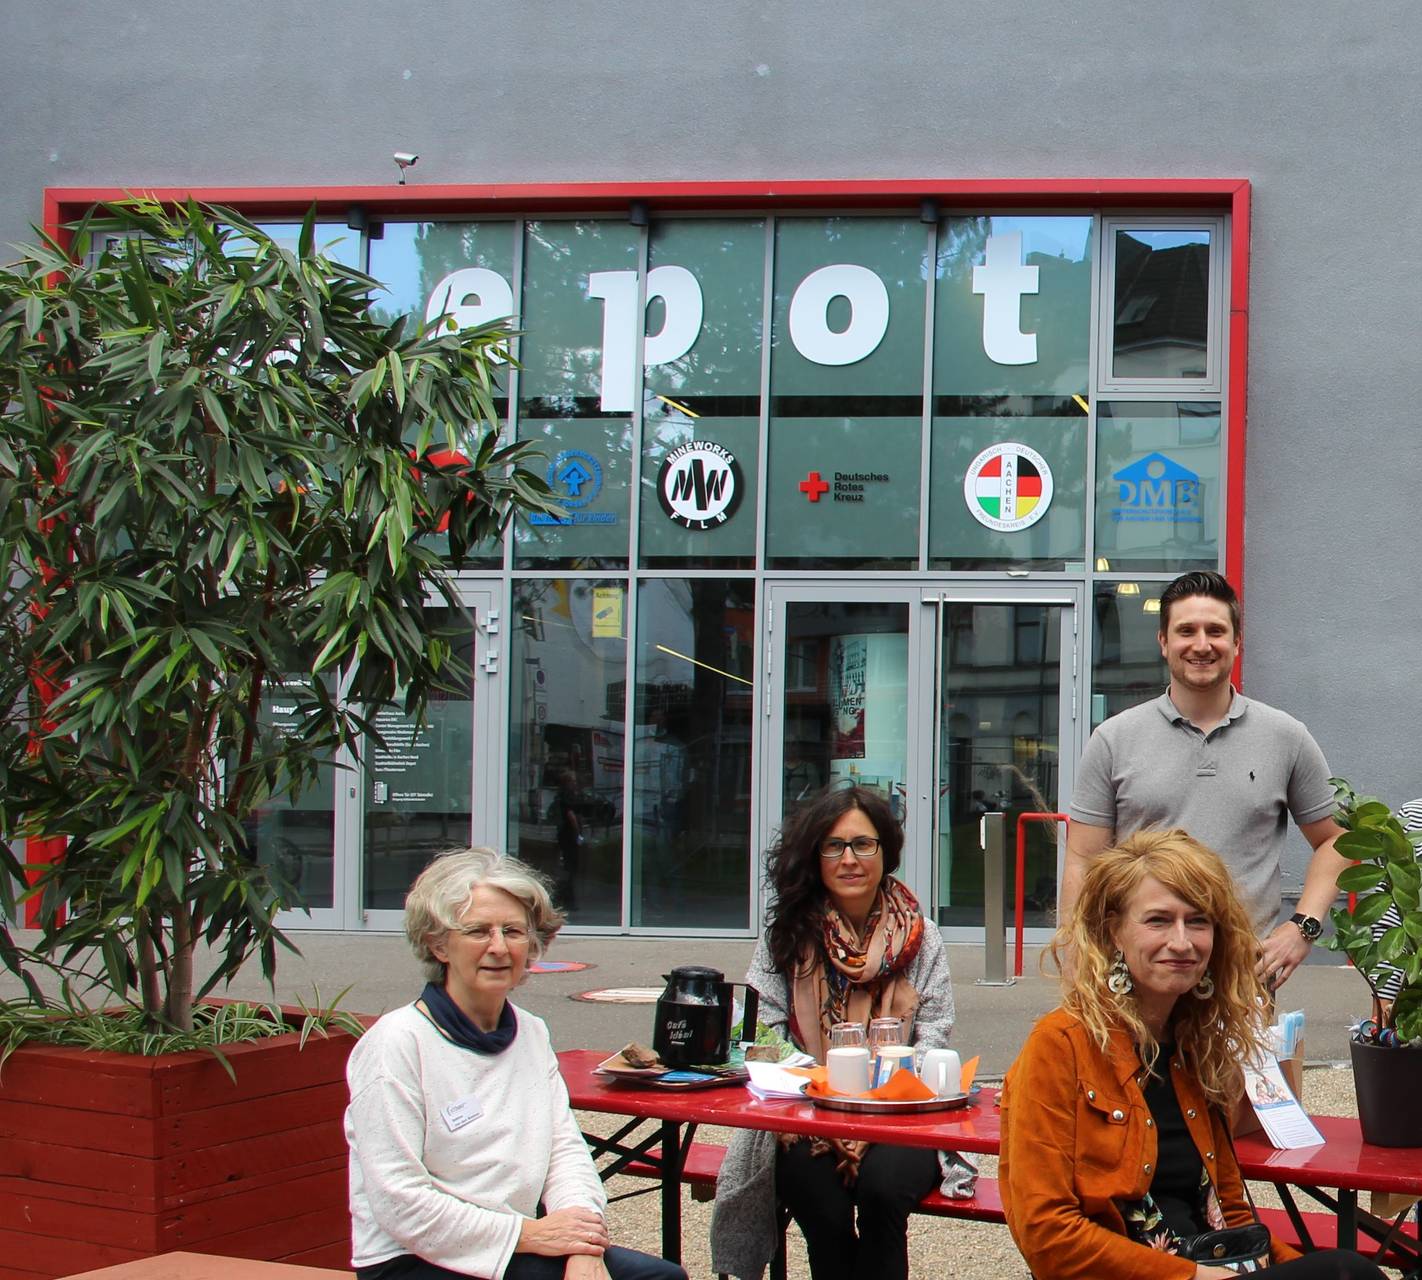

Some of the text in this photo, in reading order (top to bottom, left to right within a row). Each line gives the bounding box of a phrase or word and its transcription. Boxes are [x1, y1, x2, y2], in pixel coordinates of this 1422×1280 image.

[262, 231, 1039, 412] epot
[666, 441, 734, 465] MINEWORKS
[834, 472, 889, 482] Deutsches
[834, 482, 865, 492] Rotes
[1004, 461, 1013, 513] AACHEN
[833, 492, 865, 502] Kreuz
[670, 511, 727, 529] FILM
